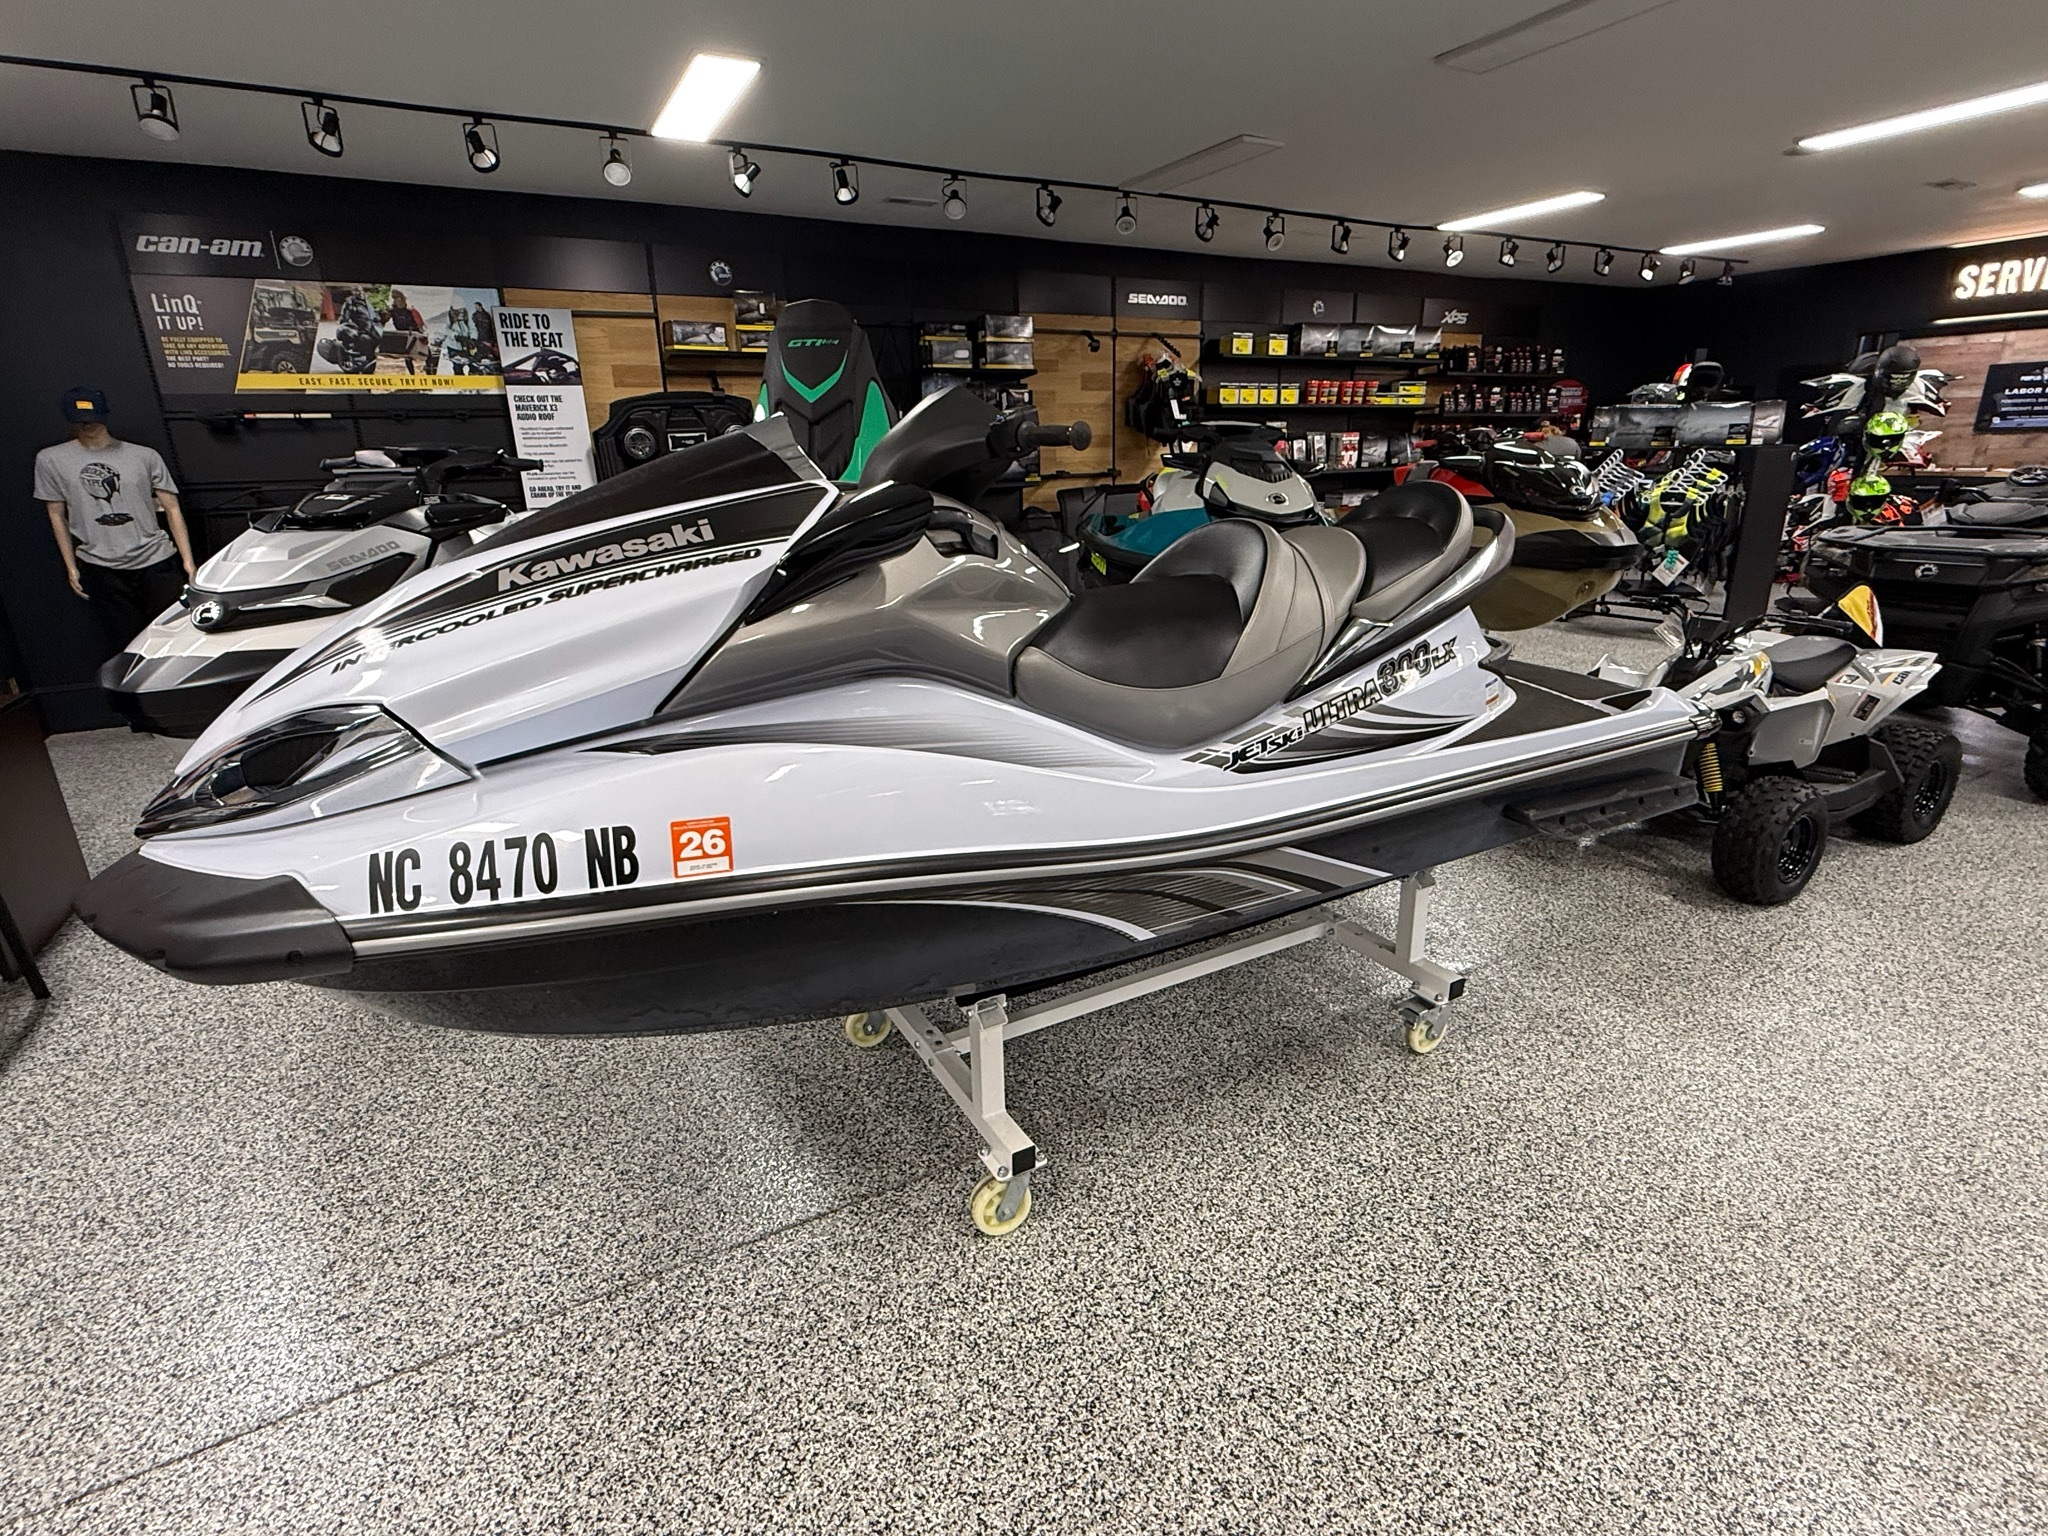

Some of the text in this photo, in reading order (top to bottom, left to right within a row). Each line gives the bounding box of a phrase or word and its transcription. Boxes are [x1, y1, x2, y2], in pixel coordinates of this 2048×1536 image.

[136, 235, 263, 258] can-am
[156, 315, 204, 331] IT UP!
[498, 312, 550, 330] RIDE TO
[1440, 309, 1469, 325] XPS
[501, 331, 563, 348] THE BEAT
[787, 339, 823, 347] GTI
[400, 378, 415, 386] TRY
[419, 378, 428, 386] IT
[432, 378, 455, 386] NOW!
[2004, 387, 2043, 395] LABOR
[498, 518, 715, 592] Kawasaki
[331, 548, 762, 675] INRCOOLED SUPERCHARGED
[1303, 678, 1383, 732] ULTRA
[679, 828, 726, 858] 26
[368, 825, 640, 915] NC 8470 NB
